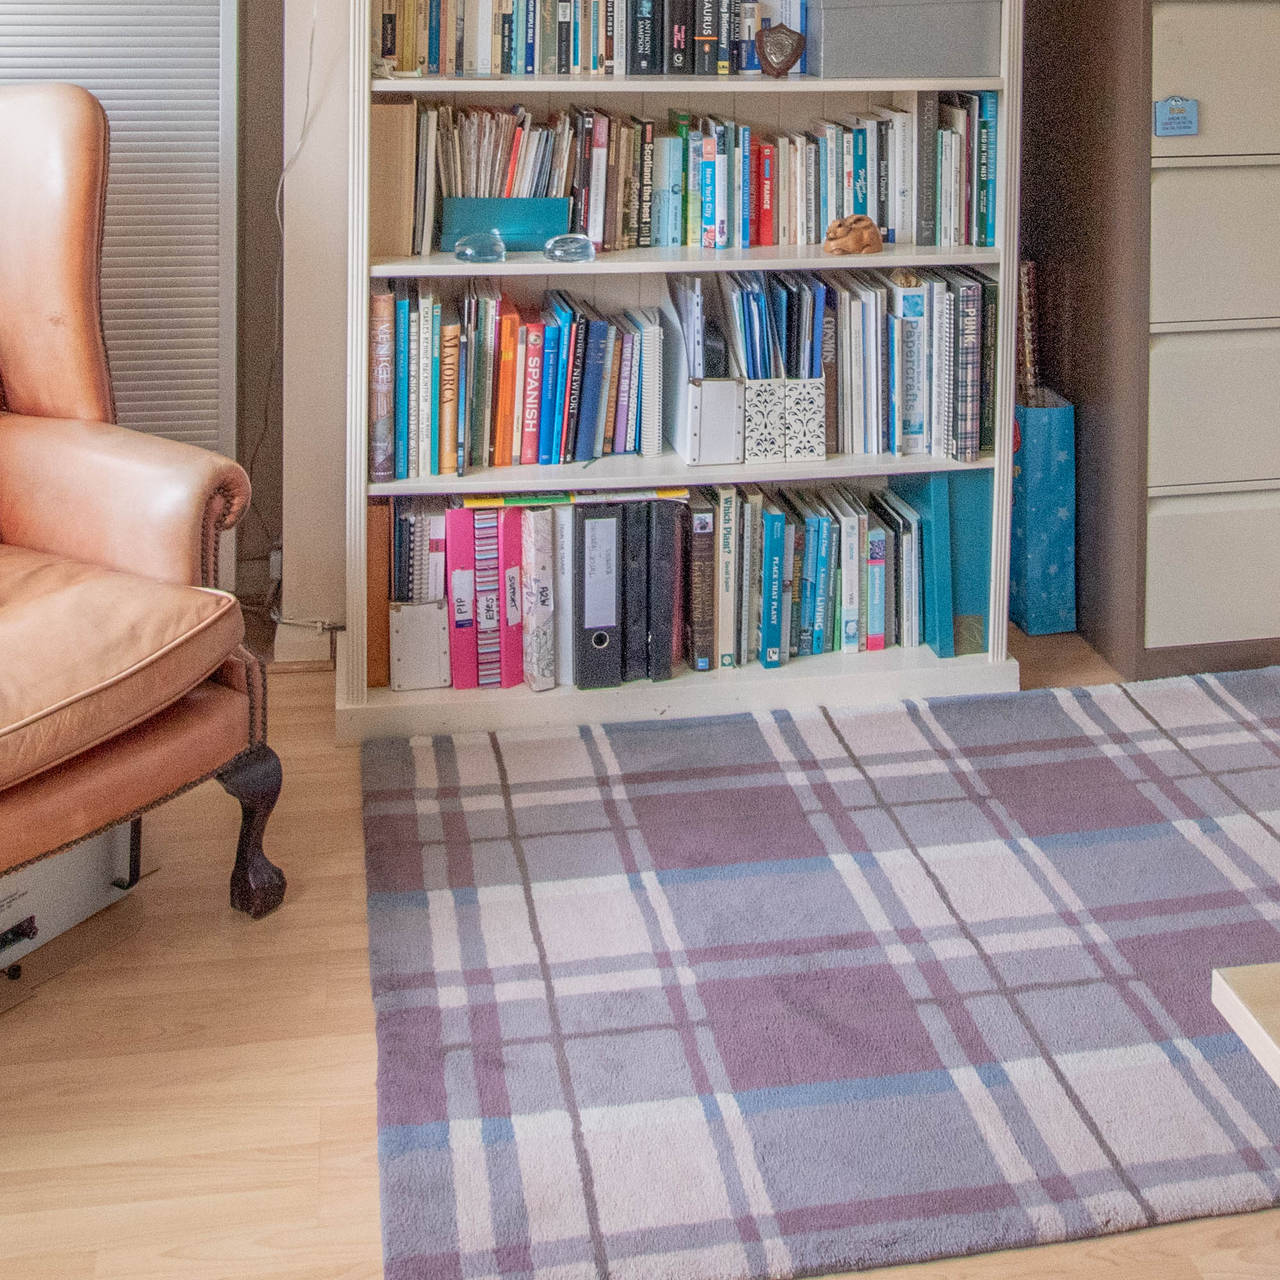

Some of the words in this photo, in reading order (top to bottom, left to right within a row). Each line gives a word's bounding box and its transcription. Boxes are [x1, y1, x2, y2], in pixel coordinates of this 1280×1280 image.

[721, 13, 729, 48] Dictionary
[643, 144, 653, 185] Scotland
[630, 182, 640, 227] Scotland
[643, 186, 651, 201] the
[642, 202, 650, 222] best
[378, 323, 389, 384] VENICE
[576, 325, 585, 357] CENTURY
[623, 343, 631, 359] YOU
[823, 317, 835, 363] COSMOS
[442, 335, 457, 404] MAJORCA
[622, 362, 630, 376] CAN
[901, 320, 919, 411] Papercrafts
[525, 356, 540, 432] SPANISH
[569, 368, 580, 414] NEWPORT
[621, 379, 629, 391] DO
[723, 496, 733, 524] Which
[723, 527, 732, 554] Plant?
[508, 575, 519, 611] SUPPORT
[693, 562, 703, 621] GARDENING
[792, 555, 801, 603] allotment
[456, 598, 468, 614] PIP
[539, 587, 549, 607] A2W
[815, 597, 825, 630] LIVING
